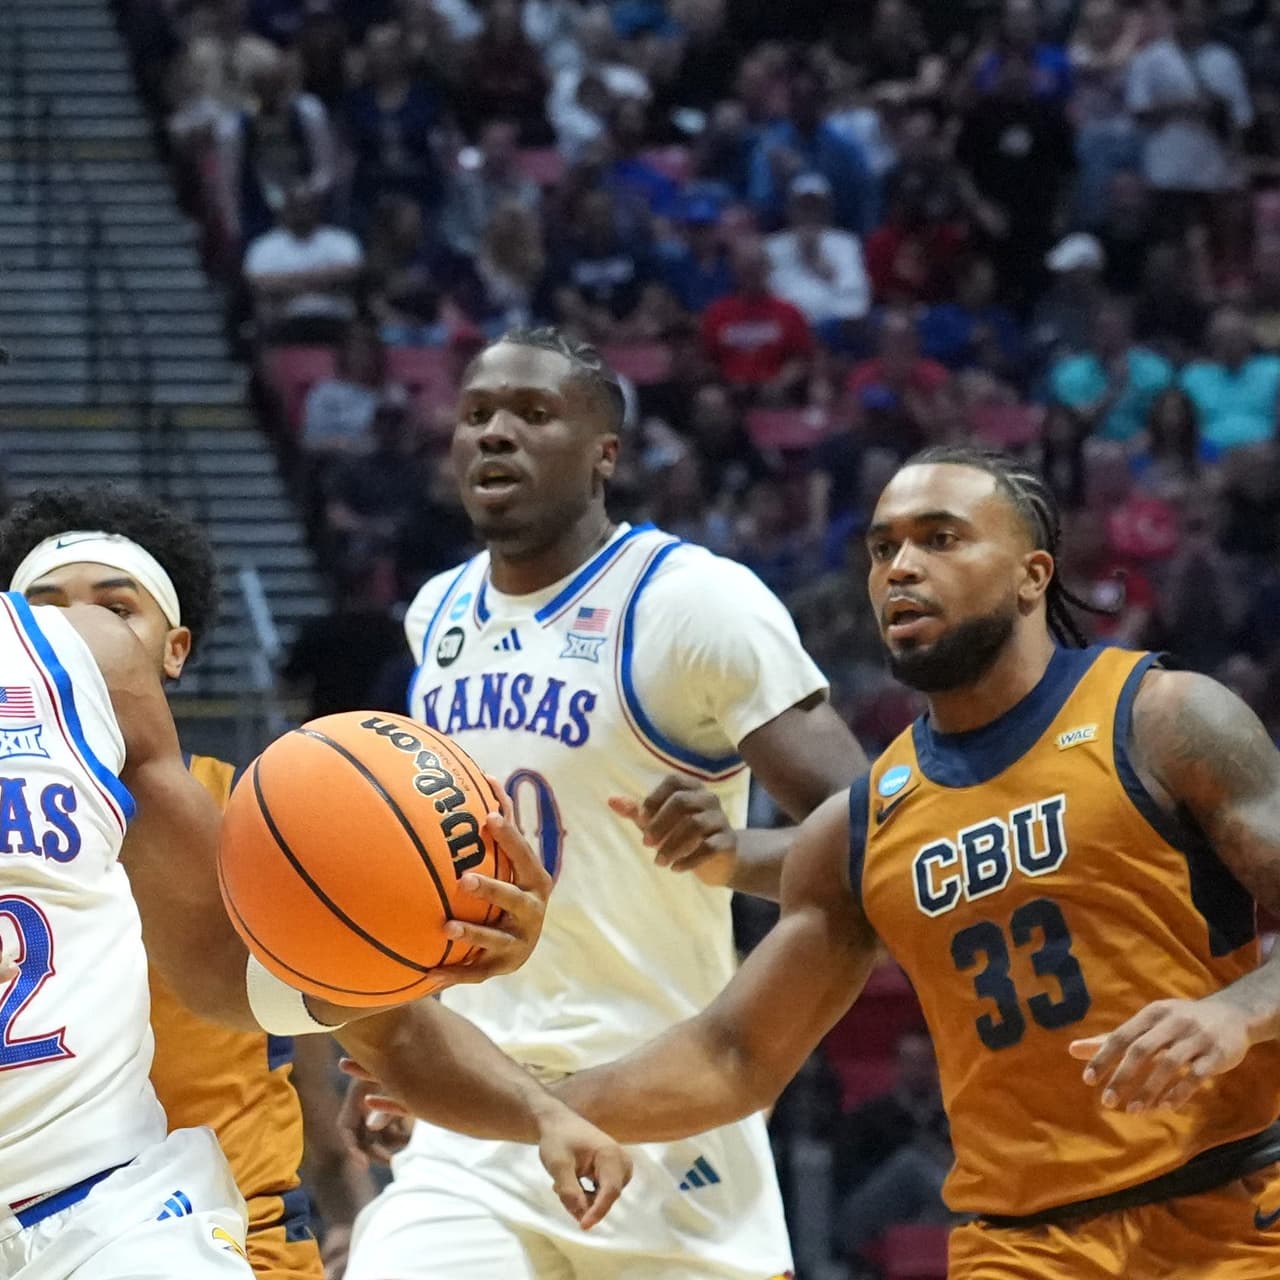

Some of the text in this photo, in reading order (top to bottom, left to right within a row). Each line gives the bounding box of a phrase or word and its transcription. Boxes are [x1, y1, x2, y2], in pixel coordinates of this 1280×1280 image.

[423, 671, 598, 748] KANSAS
[1060, 728, 1094, 745] WAC
[359, 716, 487, 881] Wilson
[912, 793, 1069, 919] CBU
[950, 896, 1092, 1052] 33
